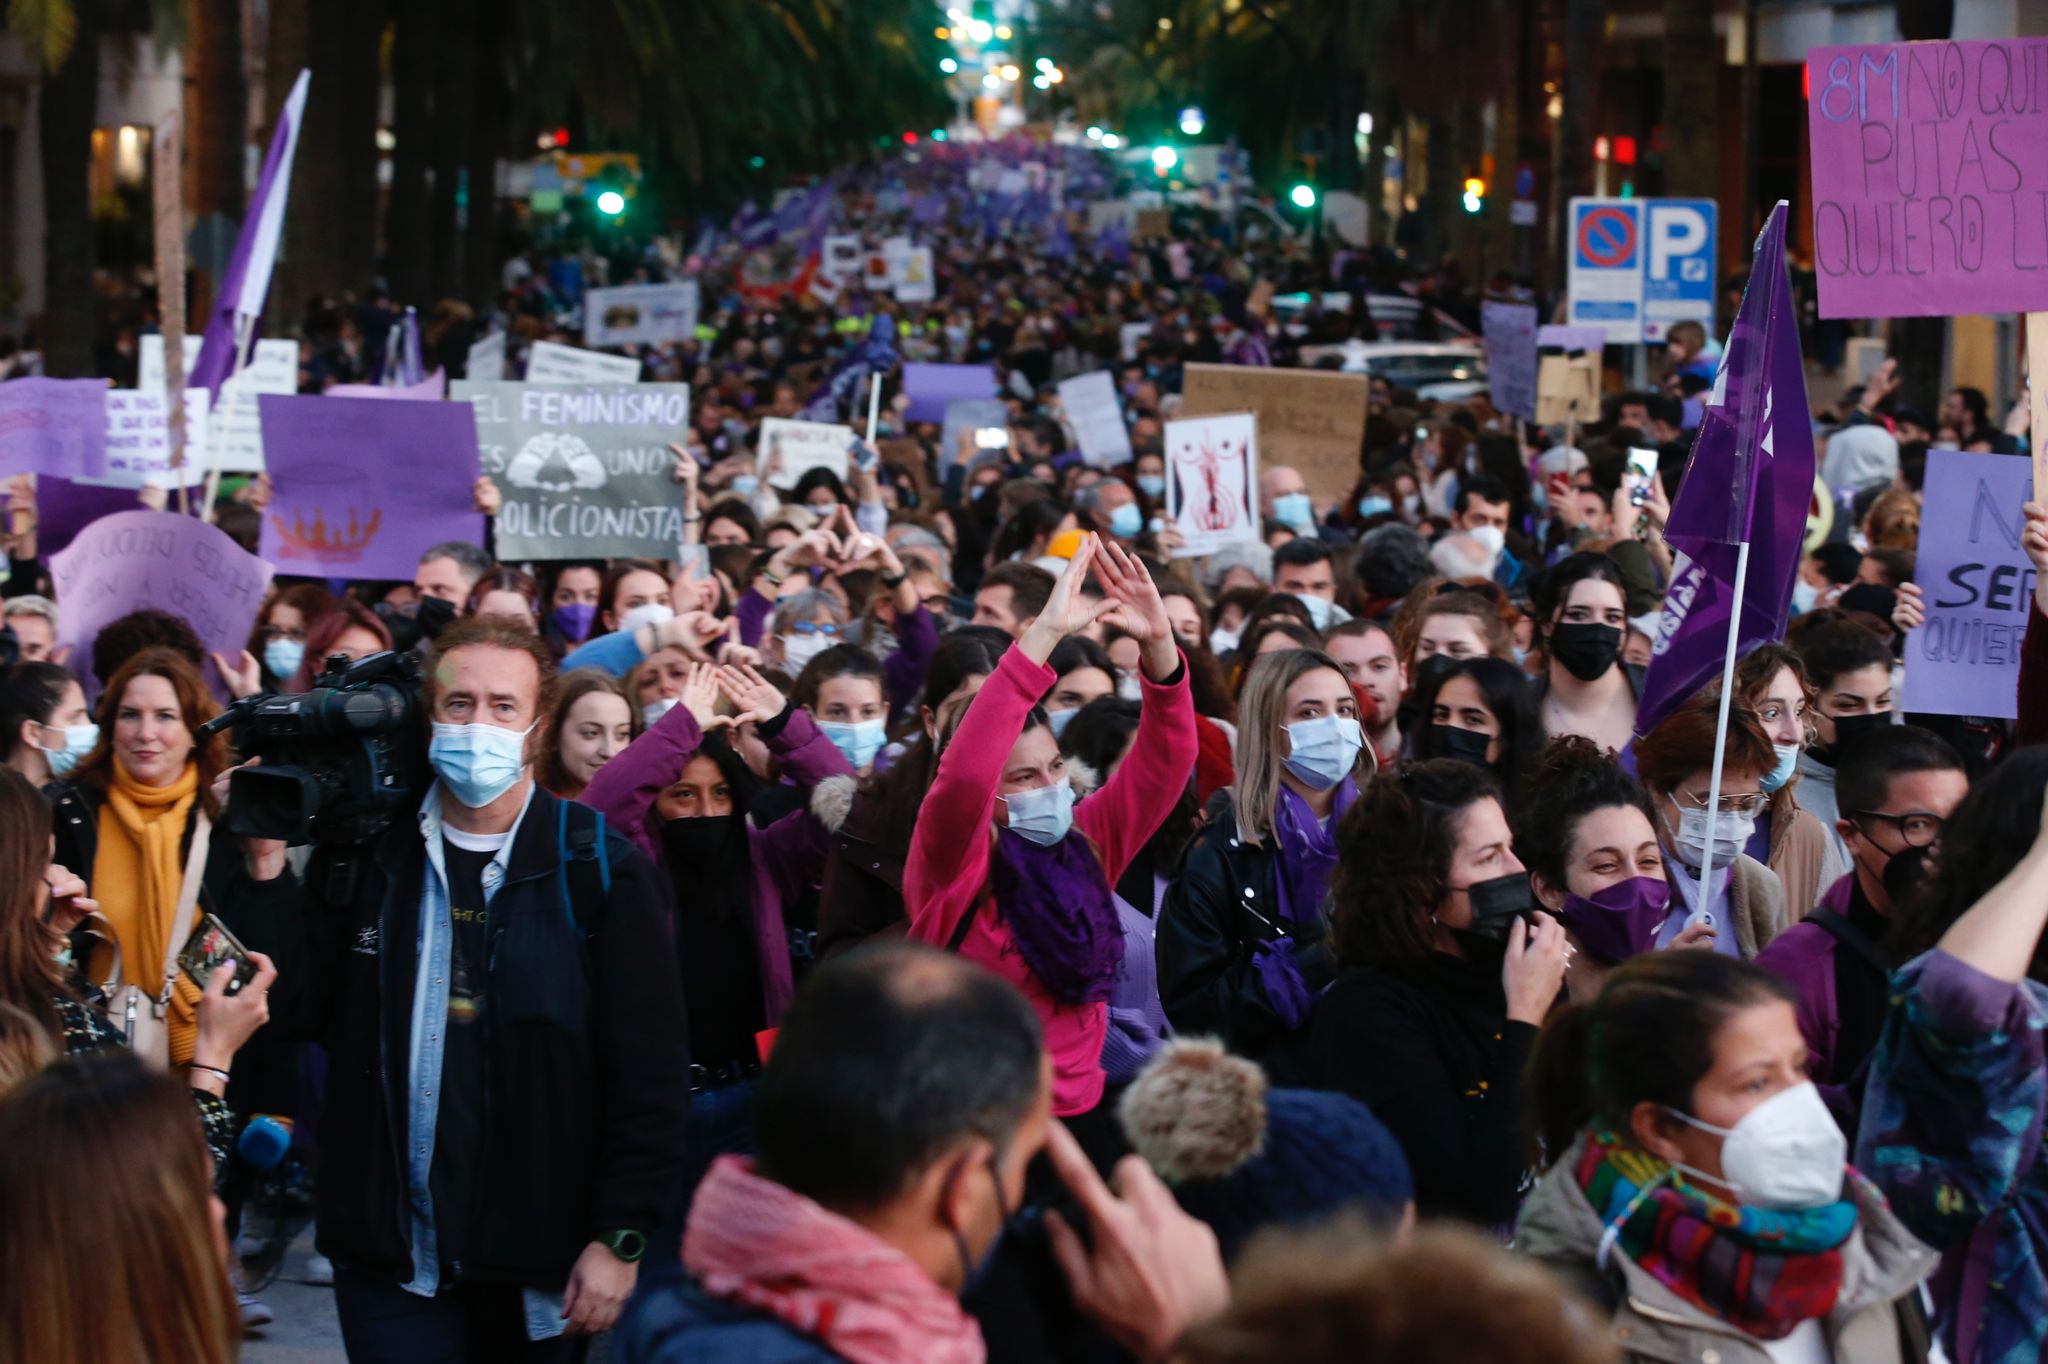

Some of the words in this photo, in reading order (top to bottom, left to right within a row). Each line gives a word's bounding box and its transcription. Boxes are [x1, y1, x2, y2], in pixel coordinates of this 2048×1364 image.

[1820, 48, 1899, 123] 8M
[1906, 42, 1965, 119] NO
[1978, 43, 2048, 115] QUI
[1860, 117, 2022, 199] PUTAS
[1651, 206, 1708, 280] P
[1815, 194, 1984, 277] QUIERO
[470, 394, 509, 424] EL
[607, 446, 668, 476] UNO
